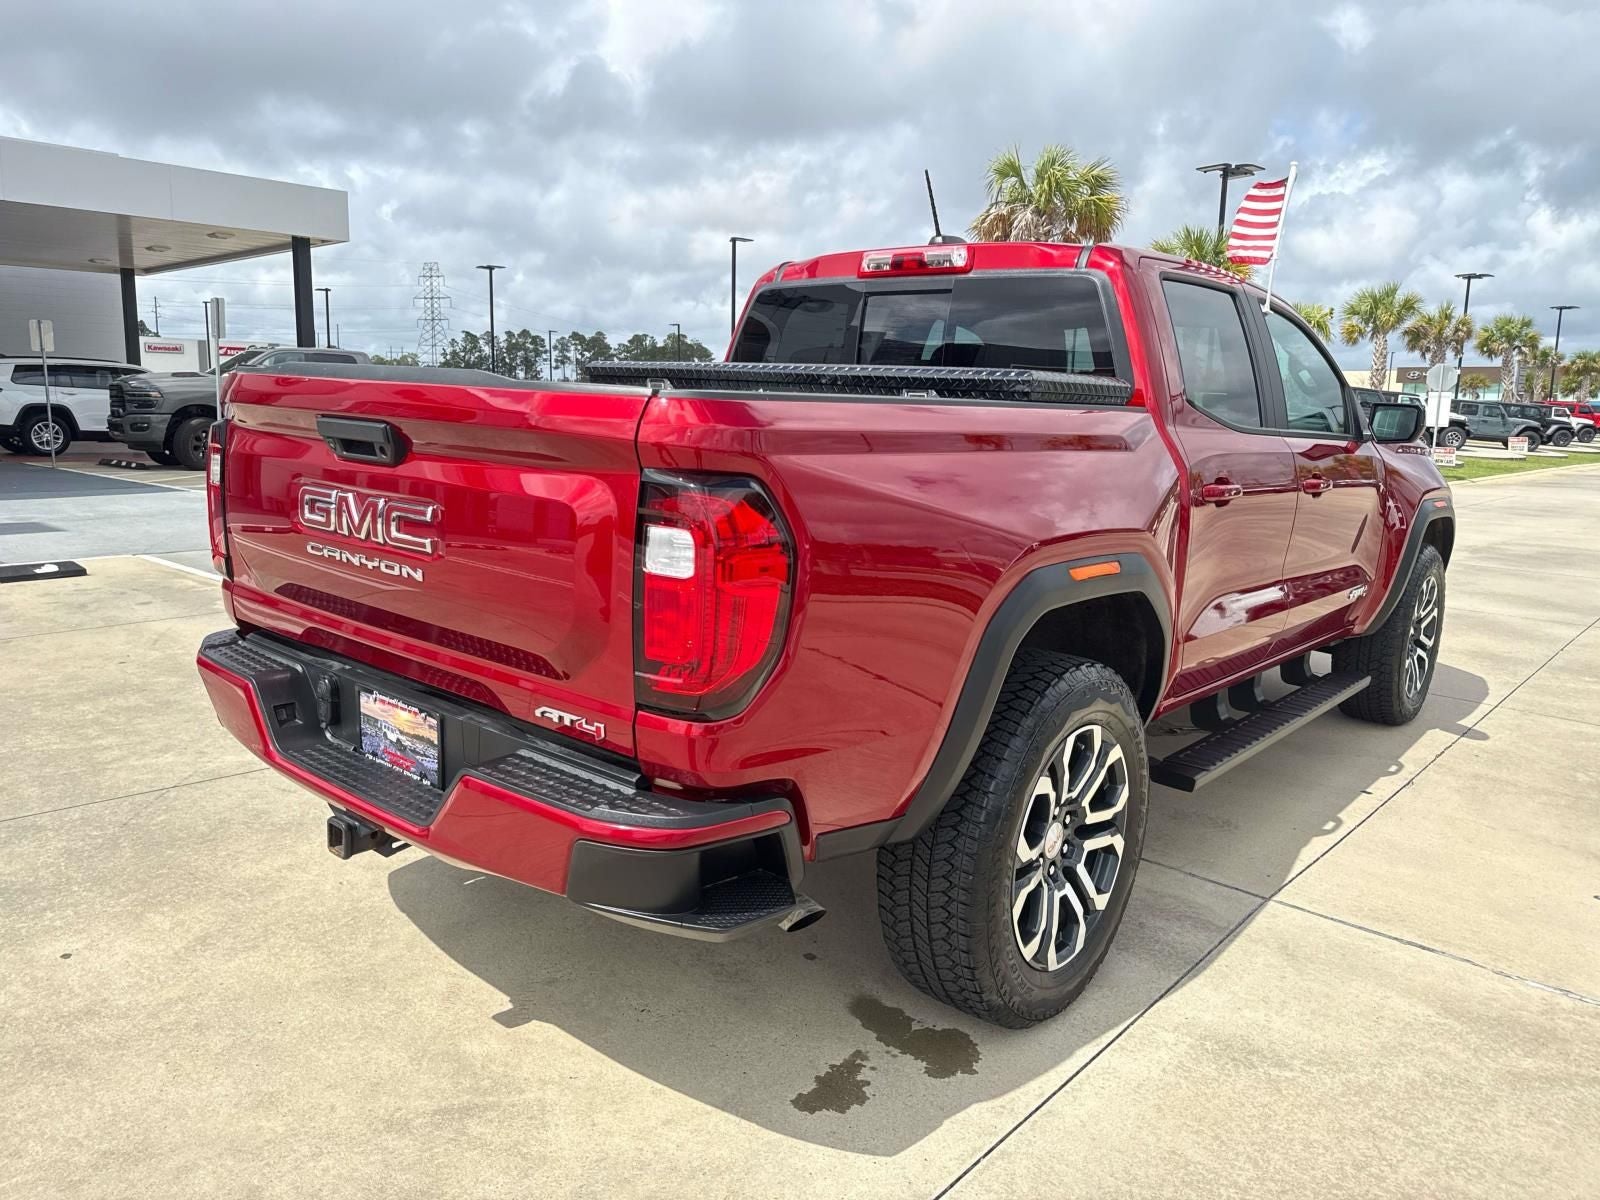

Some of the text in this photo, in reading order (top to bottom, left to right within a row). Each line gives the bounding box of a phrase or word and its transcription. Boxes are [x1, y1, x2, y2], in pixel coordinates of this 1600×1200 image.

[147, 344, 182, 352] Kawasaki
[299, 486, 433, 553] GMC
[306, 541, 424, 582] CANYON
[535, 706, 605, 741] AT4
